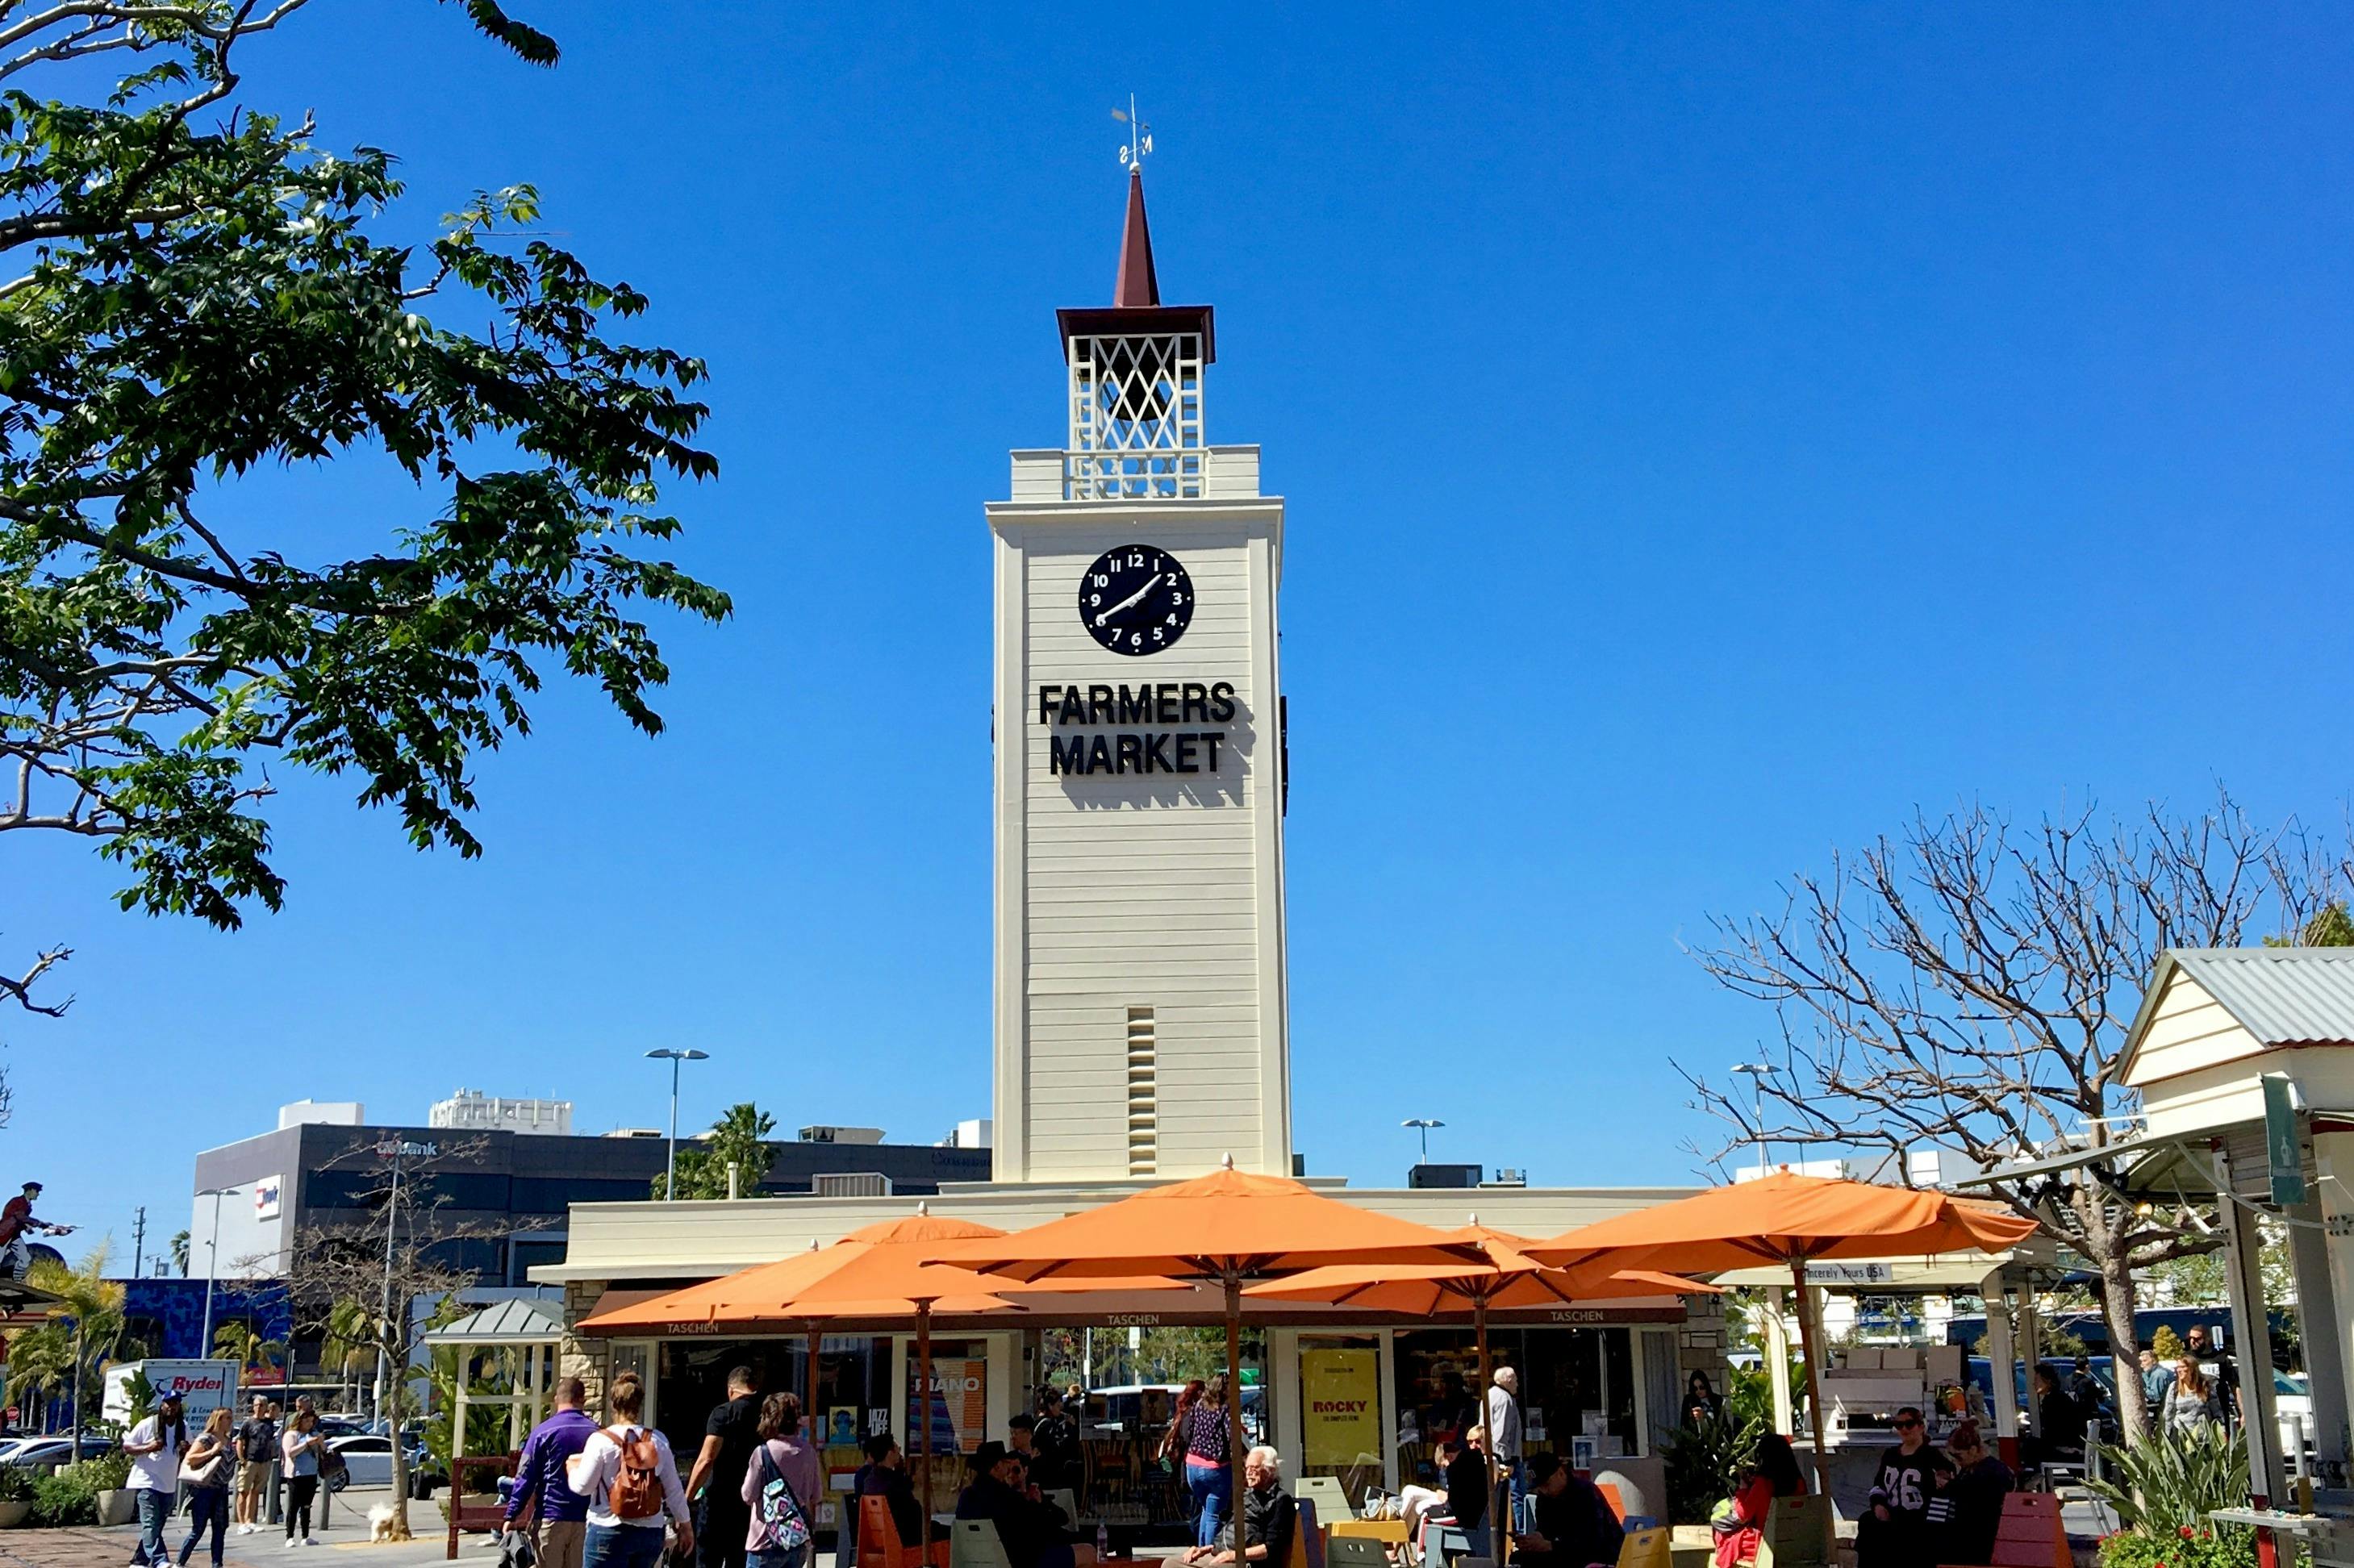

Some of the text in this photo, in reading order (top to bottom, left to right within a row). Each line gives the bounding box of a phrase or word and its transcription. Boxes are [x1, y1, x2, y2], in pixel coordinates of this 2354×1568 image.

[1111, 560, 1121, 573] 11
[1129, 554, 1144, 567] 12
[1154, 559, 1158, 571] 1
[1094, 574, 1108, 587] 10
[1167, 573, 1177, 586] 2
[1091, 594, 1101, 607] 9
[1172, 592, 1183, 605] 3
[1166, 613, 1177, 626] 4
[1112, 628, 1122, 641] 7
[1131, 632, 1142, 646] 6
[1153, 627, 1163, 640] 5
[1039, 682, 1235, 725] FARMERS
[1050, 732, 1225, 775] MARKET
[1866, 1266, 1884, 1278] USA
[1108, 1314, 1159, 1325] TASCHEN
[1551, 1311, 1604, 1322] TASCHEN
[667, 1323, 719, 1334] TASCHEN
[1313, 1400, 1367, 1413] ROCKY
[868, 1408, 888, 1428] JAZZ
